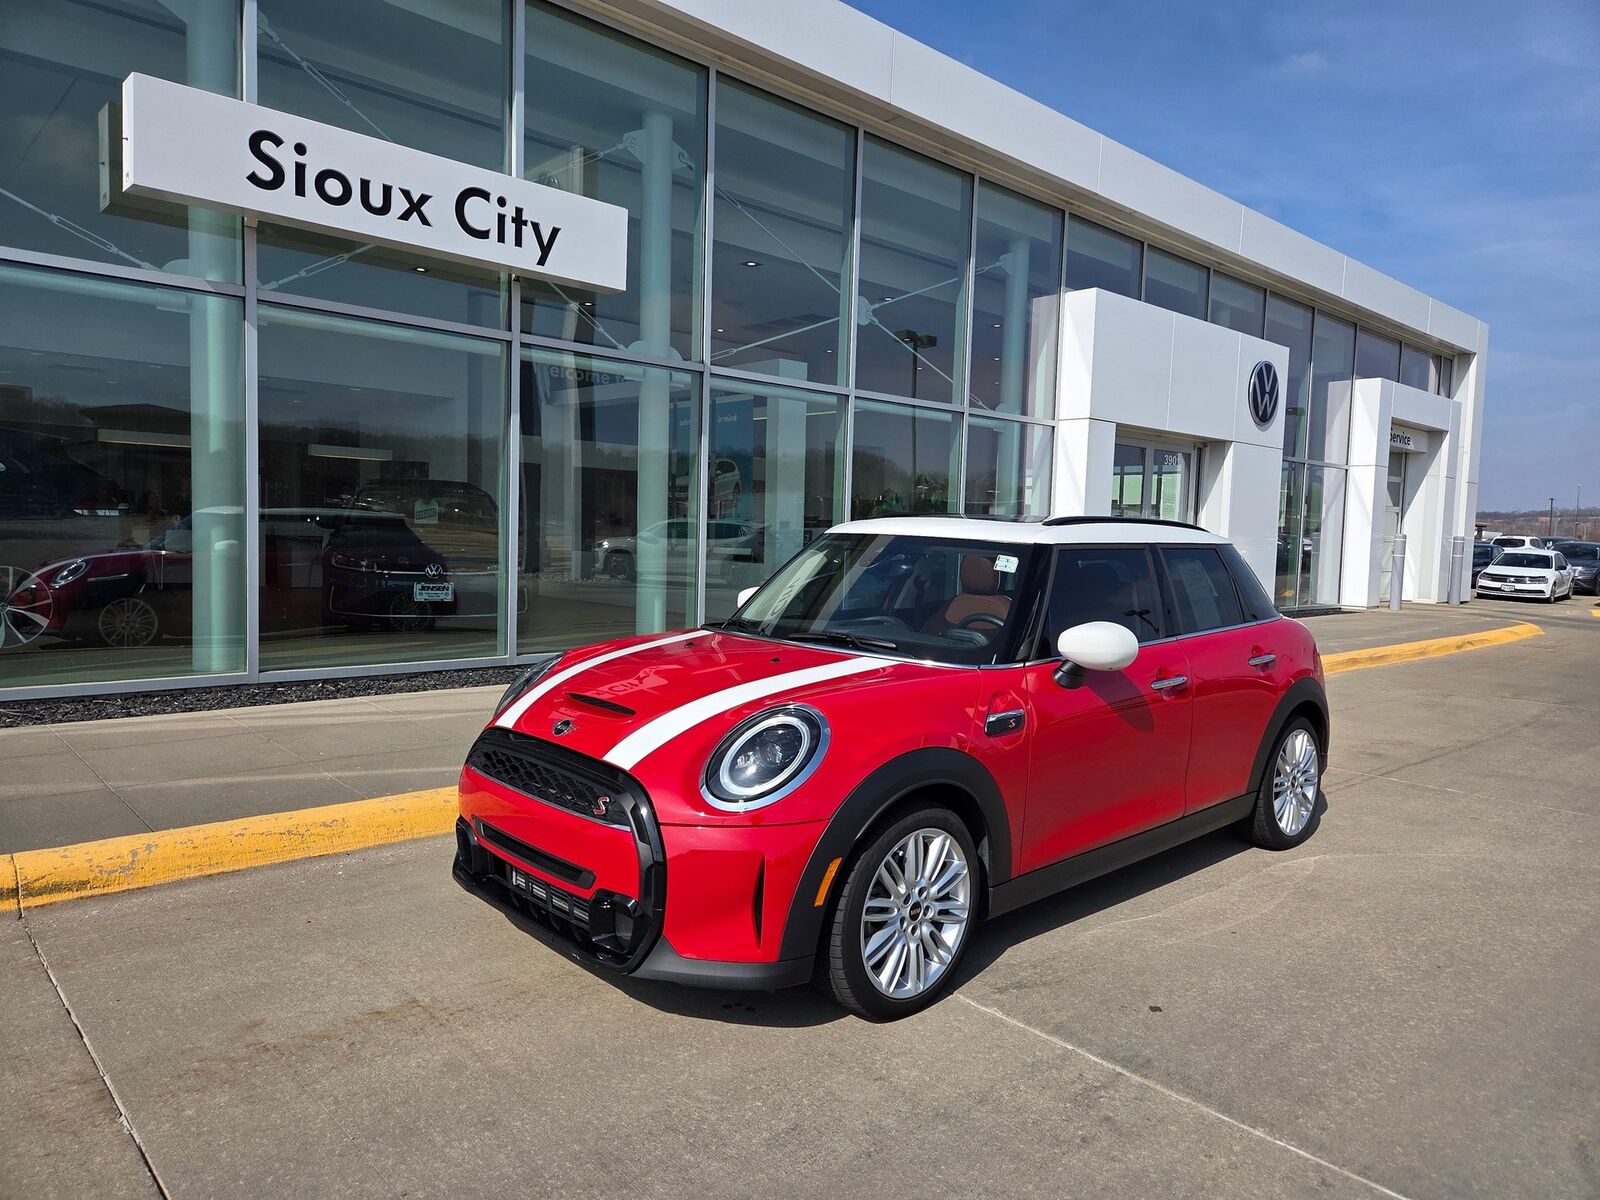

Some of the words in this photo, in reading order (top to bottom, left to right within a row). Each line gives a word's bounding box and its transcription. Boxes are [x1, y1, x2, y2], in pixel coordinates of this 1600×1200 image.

[246, 129, 434, 228] Sioux
[454, 186, 562, 267] City
[592, 796, 610, 816] S
